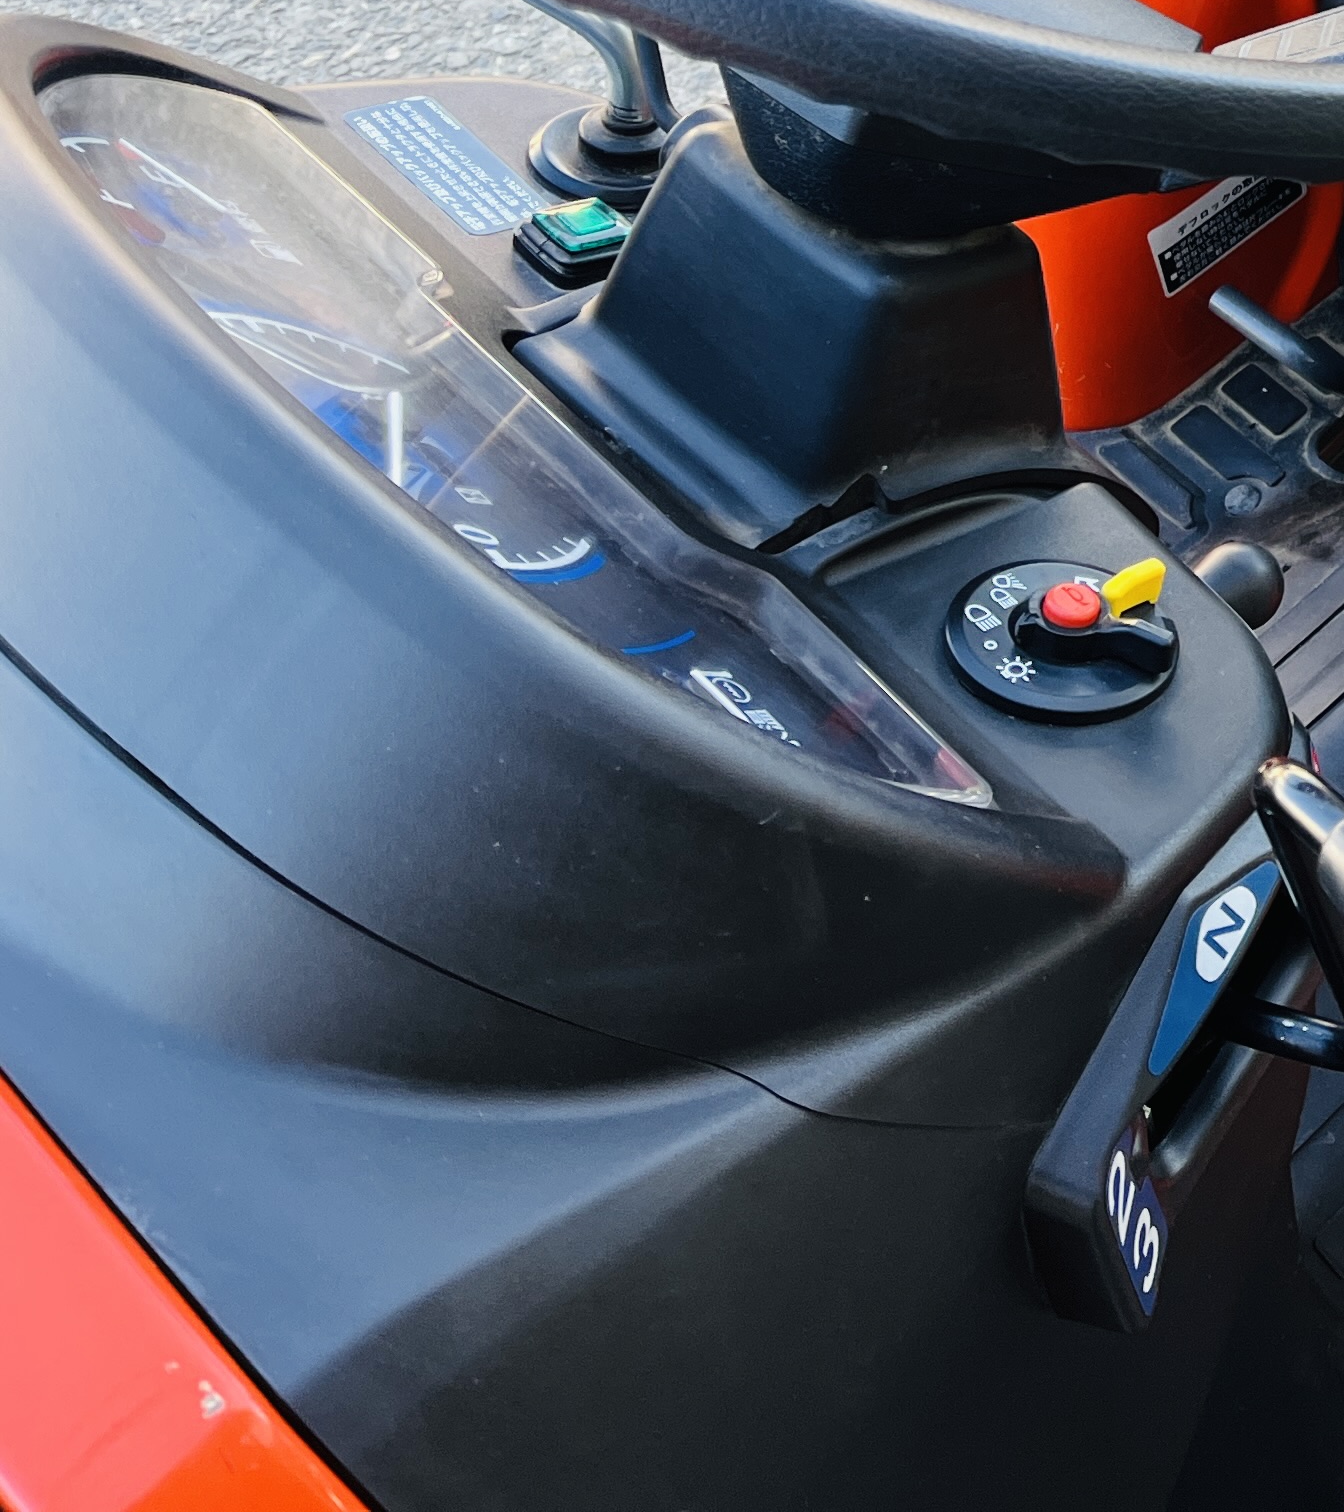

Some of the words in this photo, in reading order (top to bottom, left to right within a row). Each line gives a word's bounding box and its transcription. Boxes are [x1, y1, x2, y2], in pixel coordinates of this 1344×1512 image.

[1204, 902, 1246, 959] N
[1108, 1151, 1136, 1246] 2
[1135, 1207, 1160, 1293] 3
